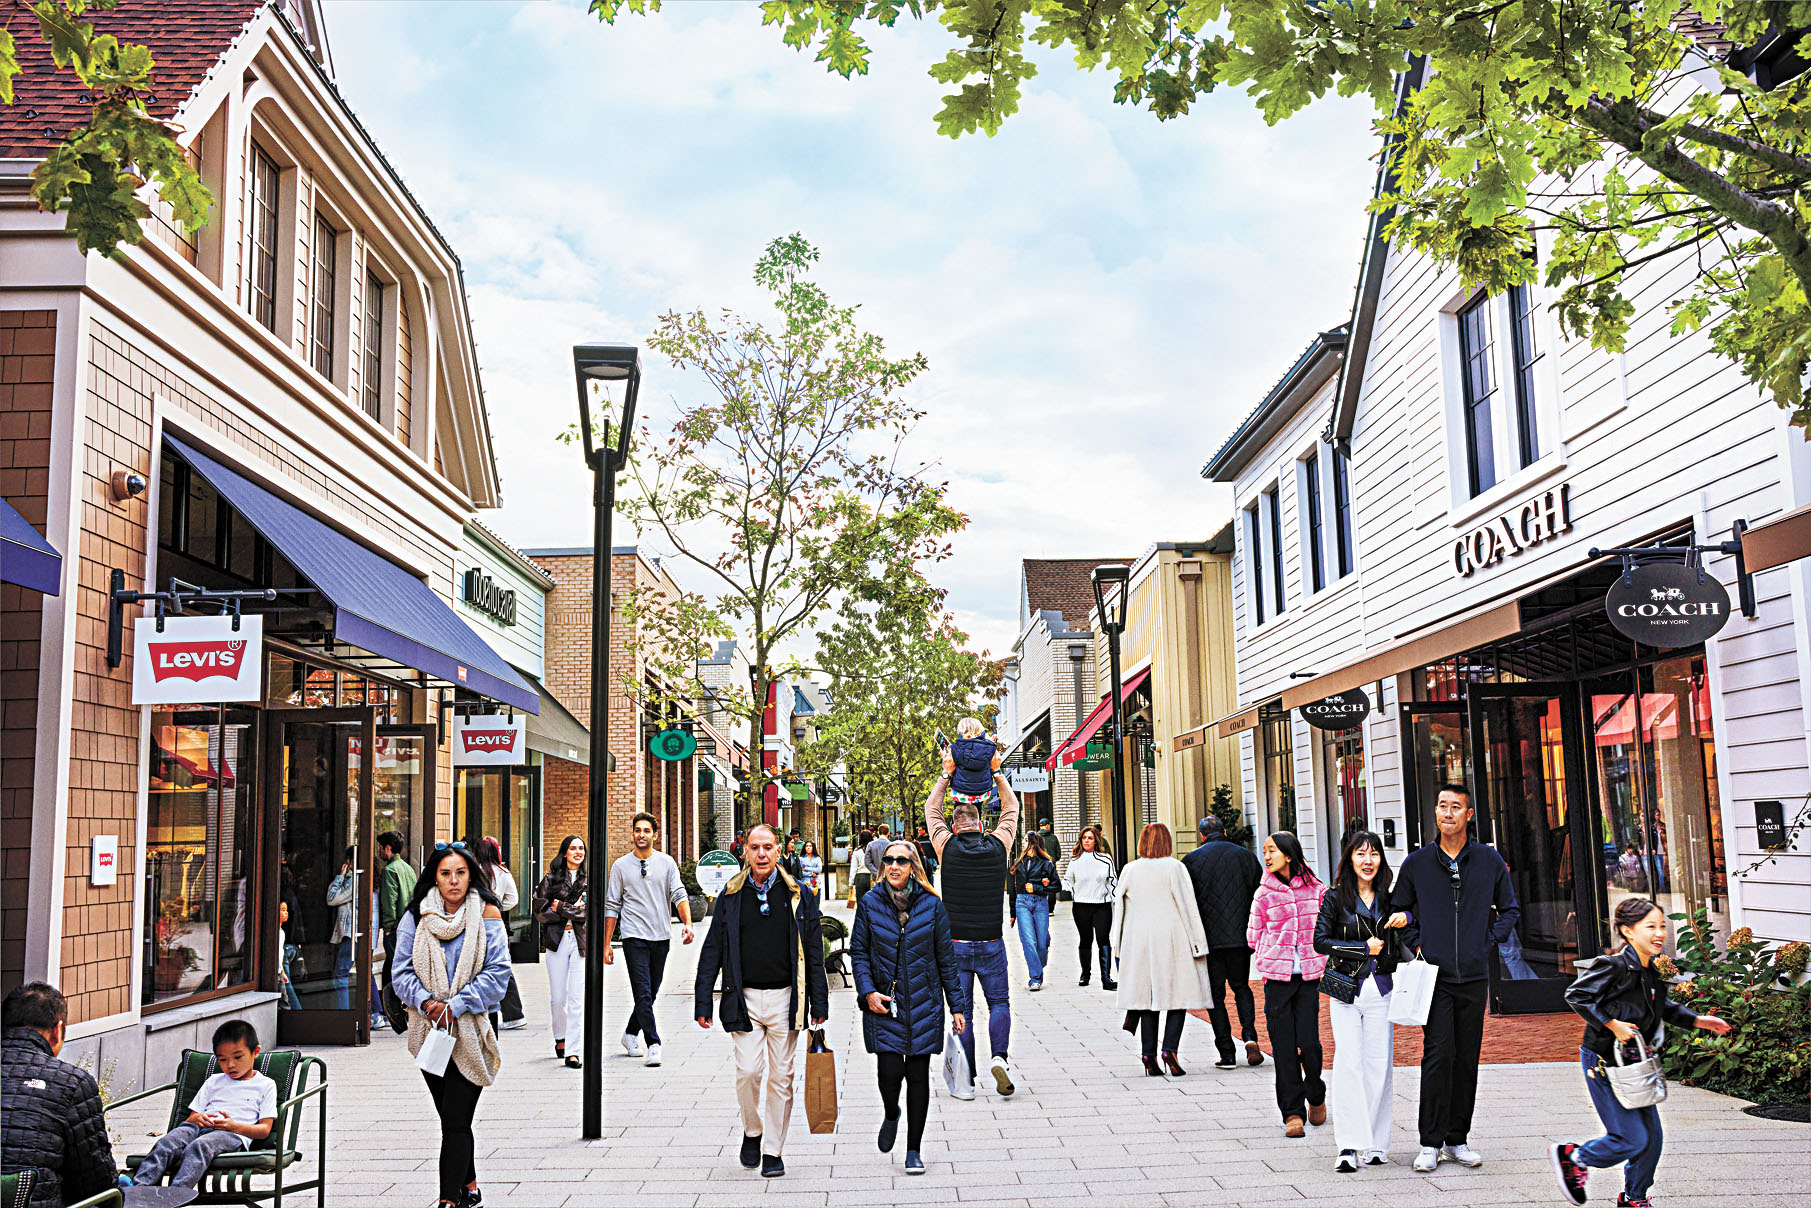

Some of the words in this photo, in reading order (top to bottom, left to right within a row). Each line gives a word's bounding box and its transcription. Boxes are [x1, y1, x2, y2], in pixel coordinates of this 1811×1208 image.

[1454, 483, 1574, 578] COACH
[1617, 602, 1721, 617] COACH
[1305, 703, 1365, 714] COACH
